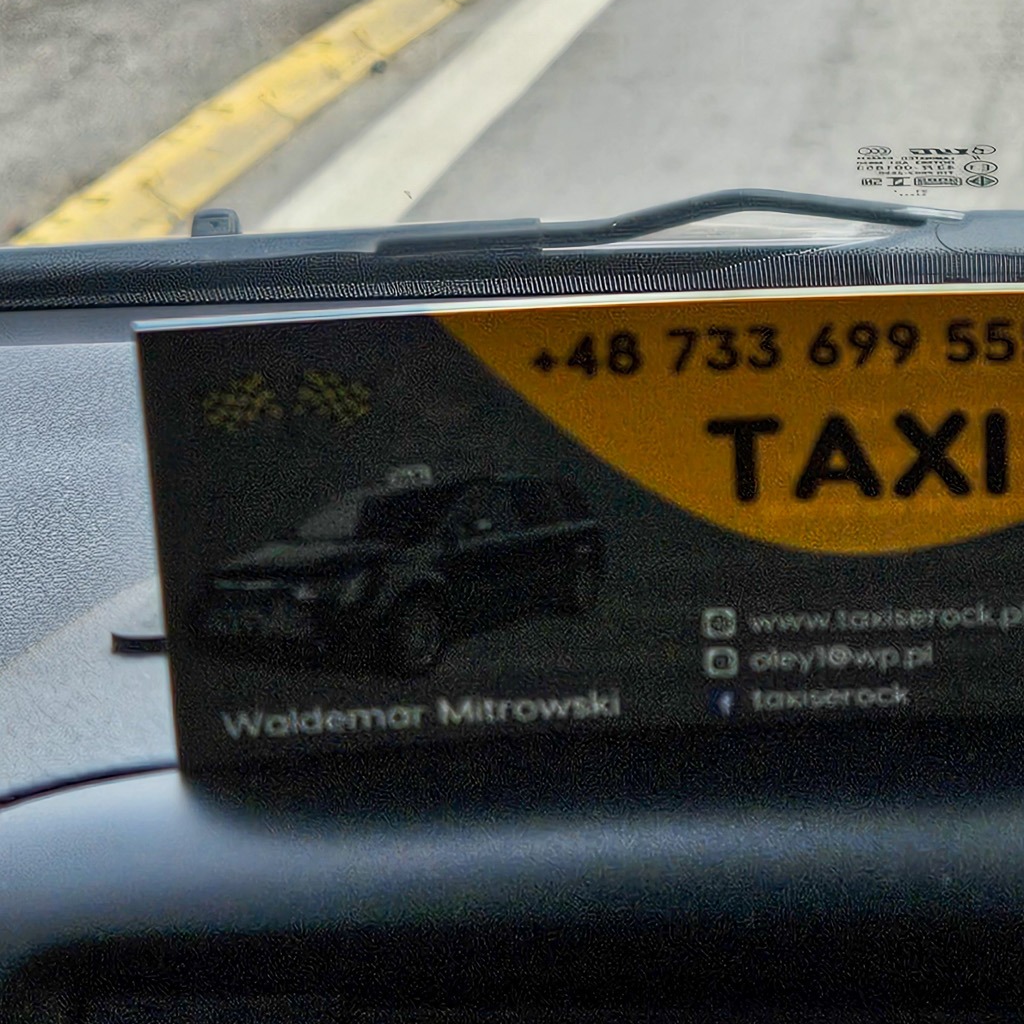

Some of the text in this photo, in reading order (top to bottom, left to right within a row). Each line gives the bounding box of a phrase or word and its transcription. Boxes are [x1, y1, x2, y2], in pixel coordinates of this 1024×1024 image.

[535, 328, 641, 376] +48
[669, 325, 780, 372] 733
[810, 320, 919, 367] 699
[706, 411, 1011, 502] TAXI
[223, 688, 621, 741] Waldemar Mitrowski
[752, 683, 910, 710] taxiserock
